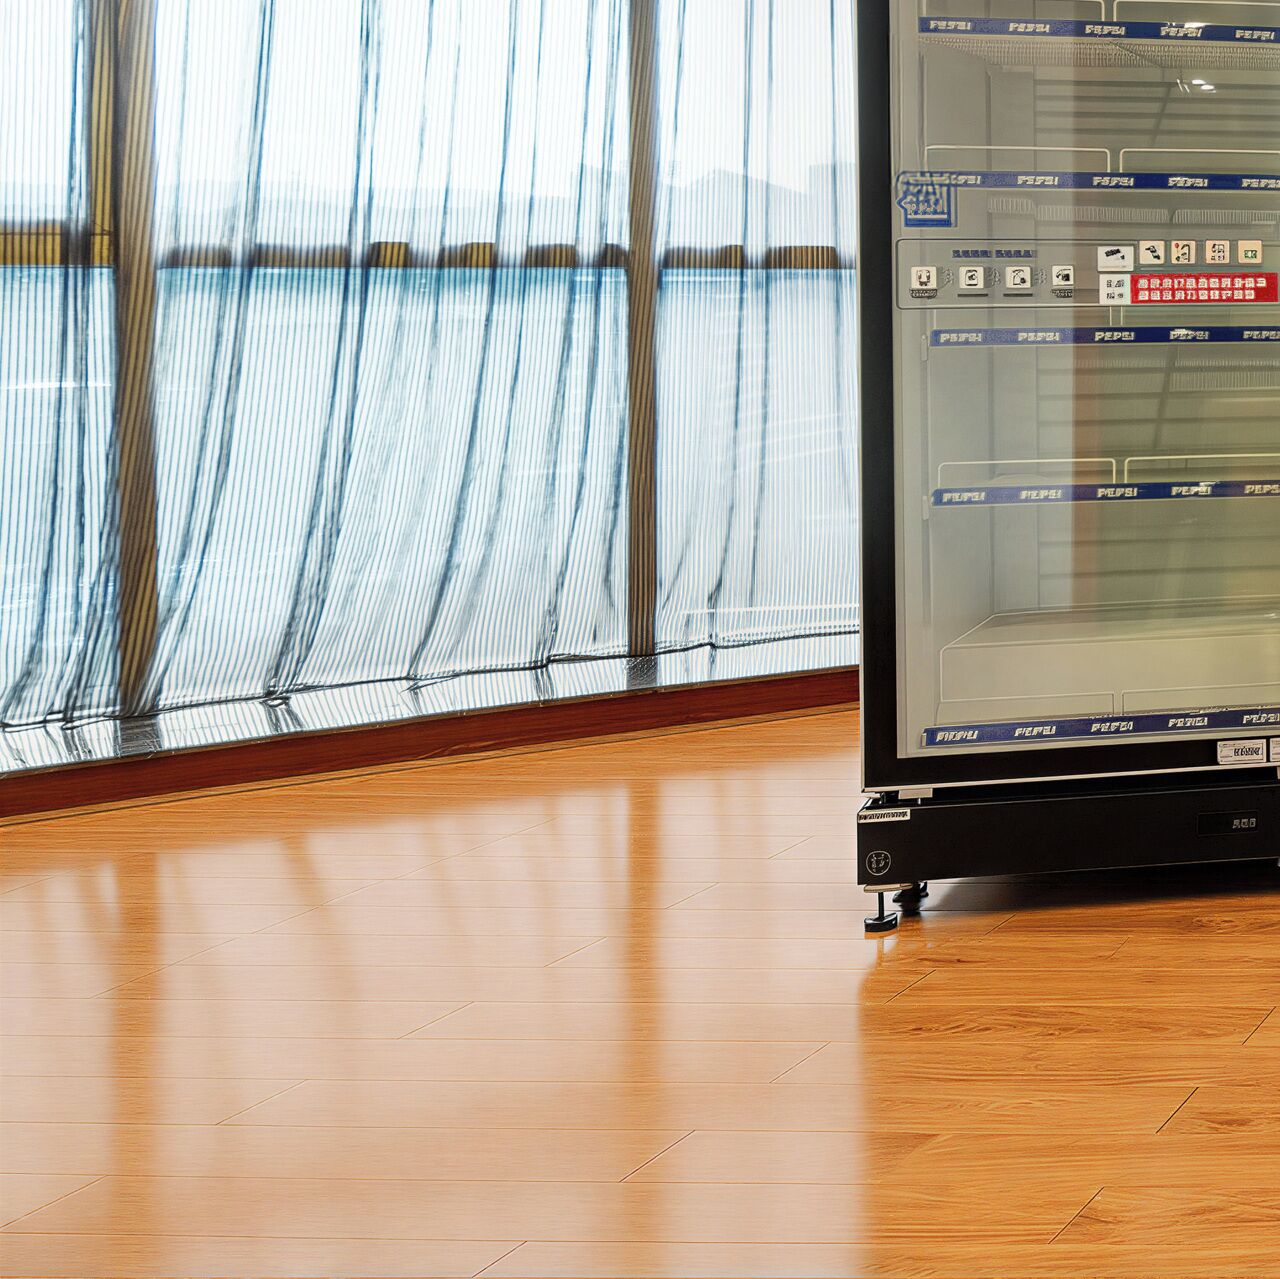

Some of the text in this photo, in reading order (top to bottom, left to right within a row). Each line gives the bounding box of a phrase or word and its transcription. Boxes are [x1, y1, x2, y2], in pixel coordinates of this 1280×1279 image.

[1095, 331, 1134, 341] PEPSI
[1097, 487, 1138, 498] PEPSI
[1171, 485, 1212, 496] PEPSI
